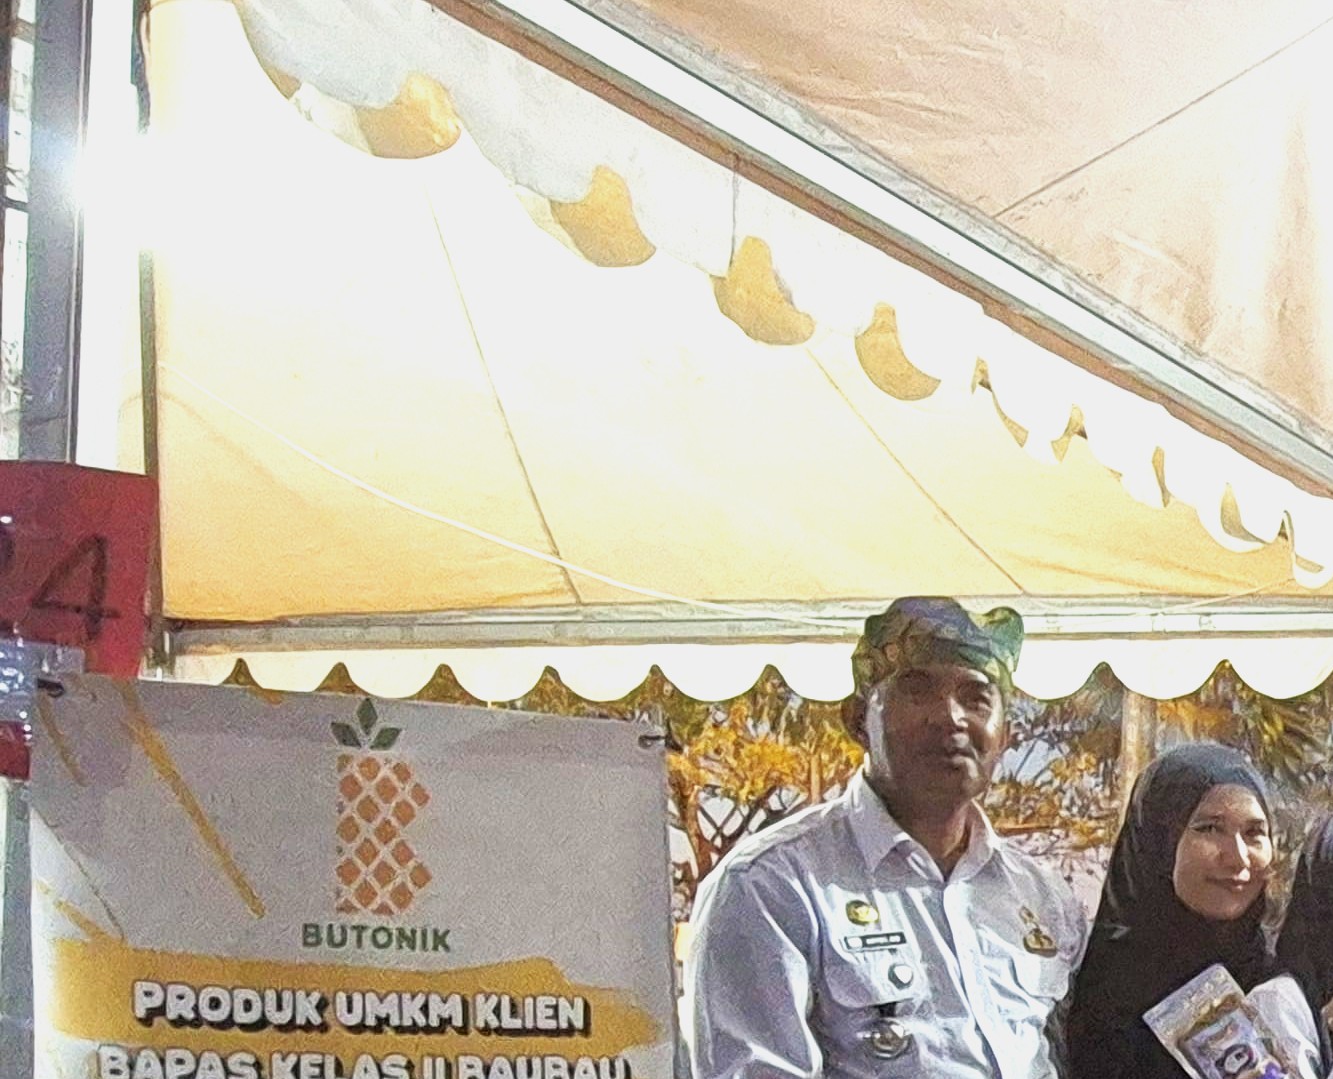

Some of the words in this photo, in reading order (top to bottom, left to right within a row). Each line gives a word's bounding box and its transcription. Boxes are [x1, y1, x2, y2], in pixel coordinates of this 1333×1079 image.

[302, 923, 451, 953] BUTONIK
[132, 980, 328, 1032] PRODUK
[335, 990, 470, 1035] UMKM
[475, 995, 591, 1037] KLIEN
